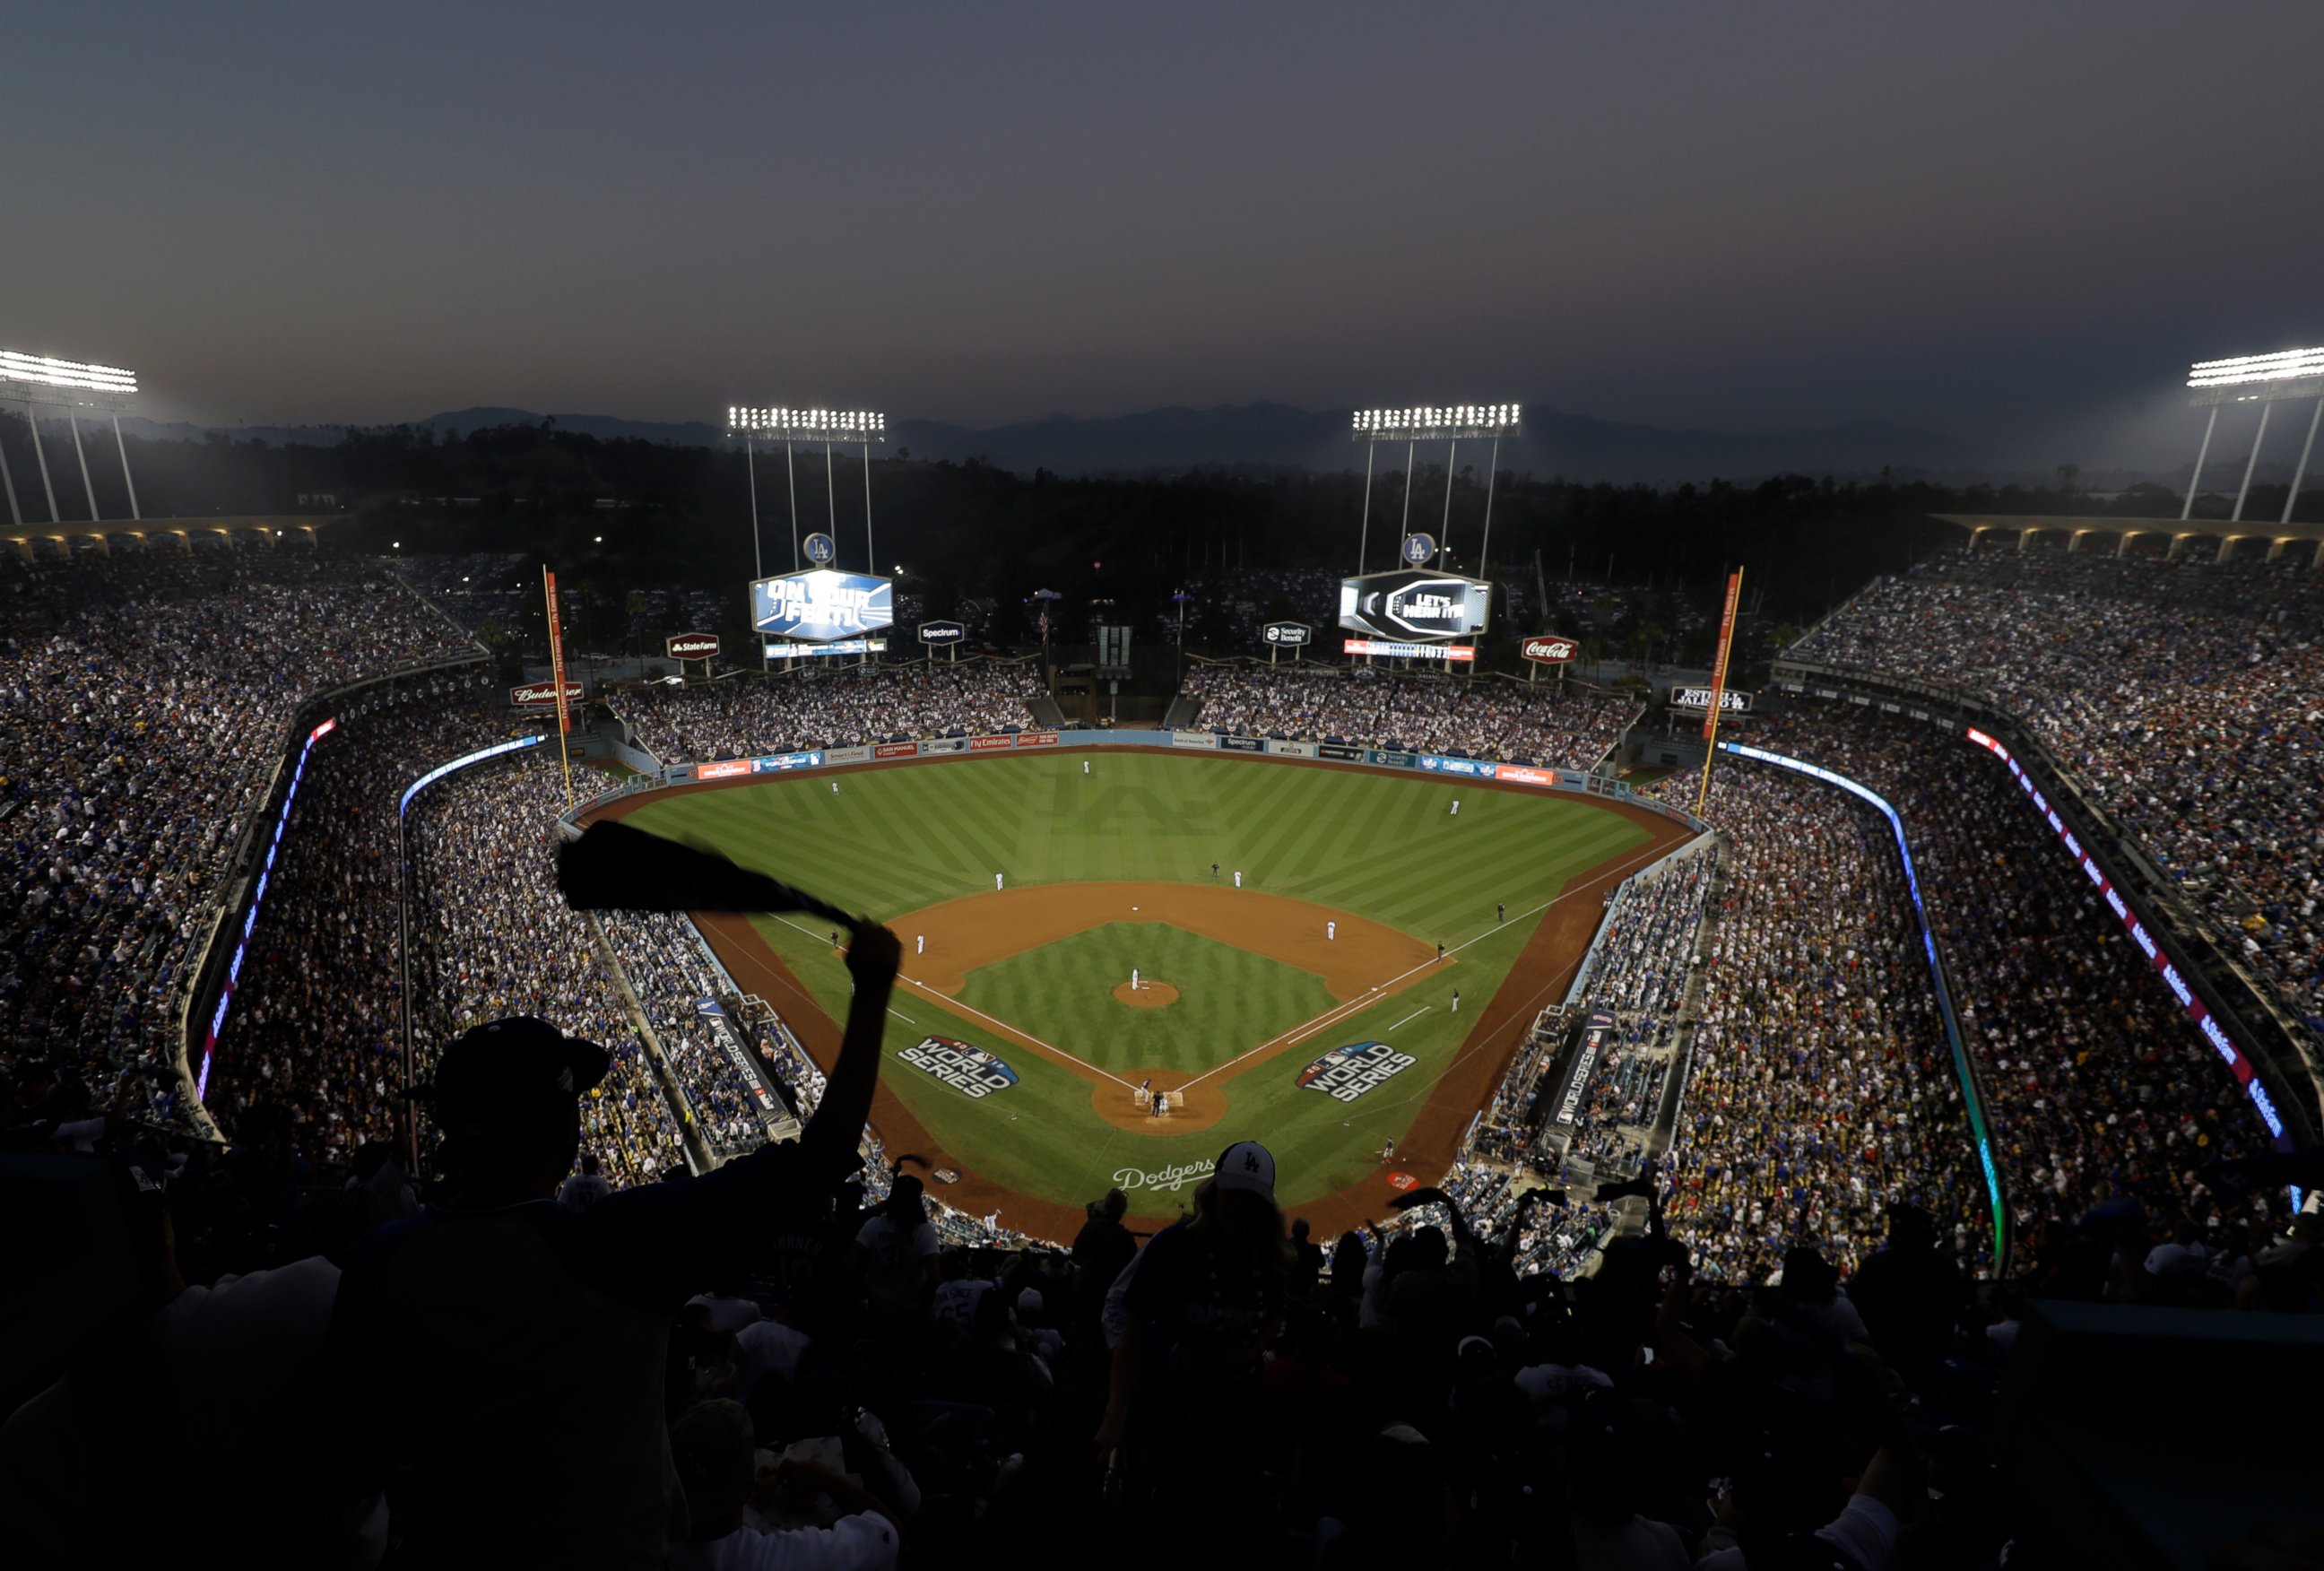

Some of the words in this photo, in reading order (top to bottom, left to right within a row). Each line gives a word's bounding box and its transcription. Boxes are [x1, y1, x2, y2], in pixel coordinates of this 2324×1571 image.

[813, 538, 828, 559] LA
[1409, 538, 1425, 560] LA
[767, 580, 805, 602] ON
[923, 629, 958, 638] Spectrum
[1280, 627, 1306, 637] Security
[1280, 634, 1302, 642] Benefit
[515, 688, 582, 702] Budwser
[1678, 695, 1730, 708] JALISO
[970, 740, 982, 748] Fly
[982, 738, 1010, 747] Emirates
[1227, 738, 1256, 746] Spectrum
[715, 1024, 740, 1053] WORLD
[730, 1051, 758, 1081] SERIES
[917, 1037, 1011, 1089] WORLD
[898, 1047, 1002, 1098] SERIES
[1305, 1044, 1395, 1092] WORLD
[1331, 1053, 1418, 1102] SERIES
[1562, 1081, 1584, 1114] WORLD
[1574, 1053, 1596, 1083] SERIES
[1244, 1151, 1260, 1173] LA
[1112, 1159, 1216, 1192] Dodgers
